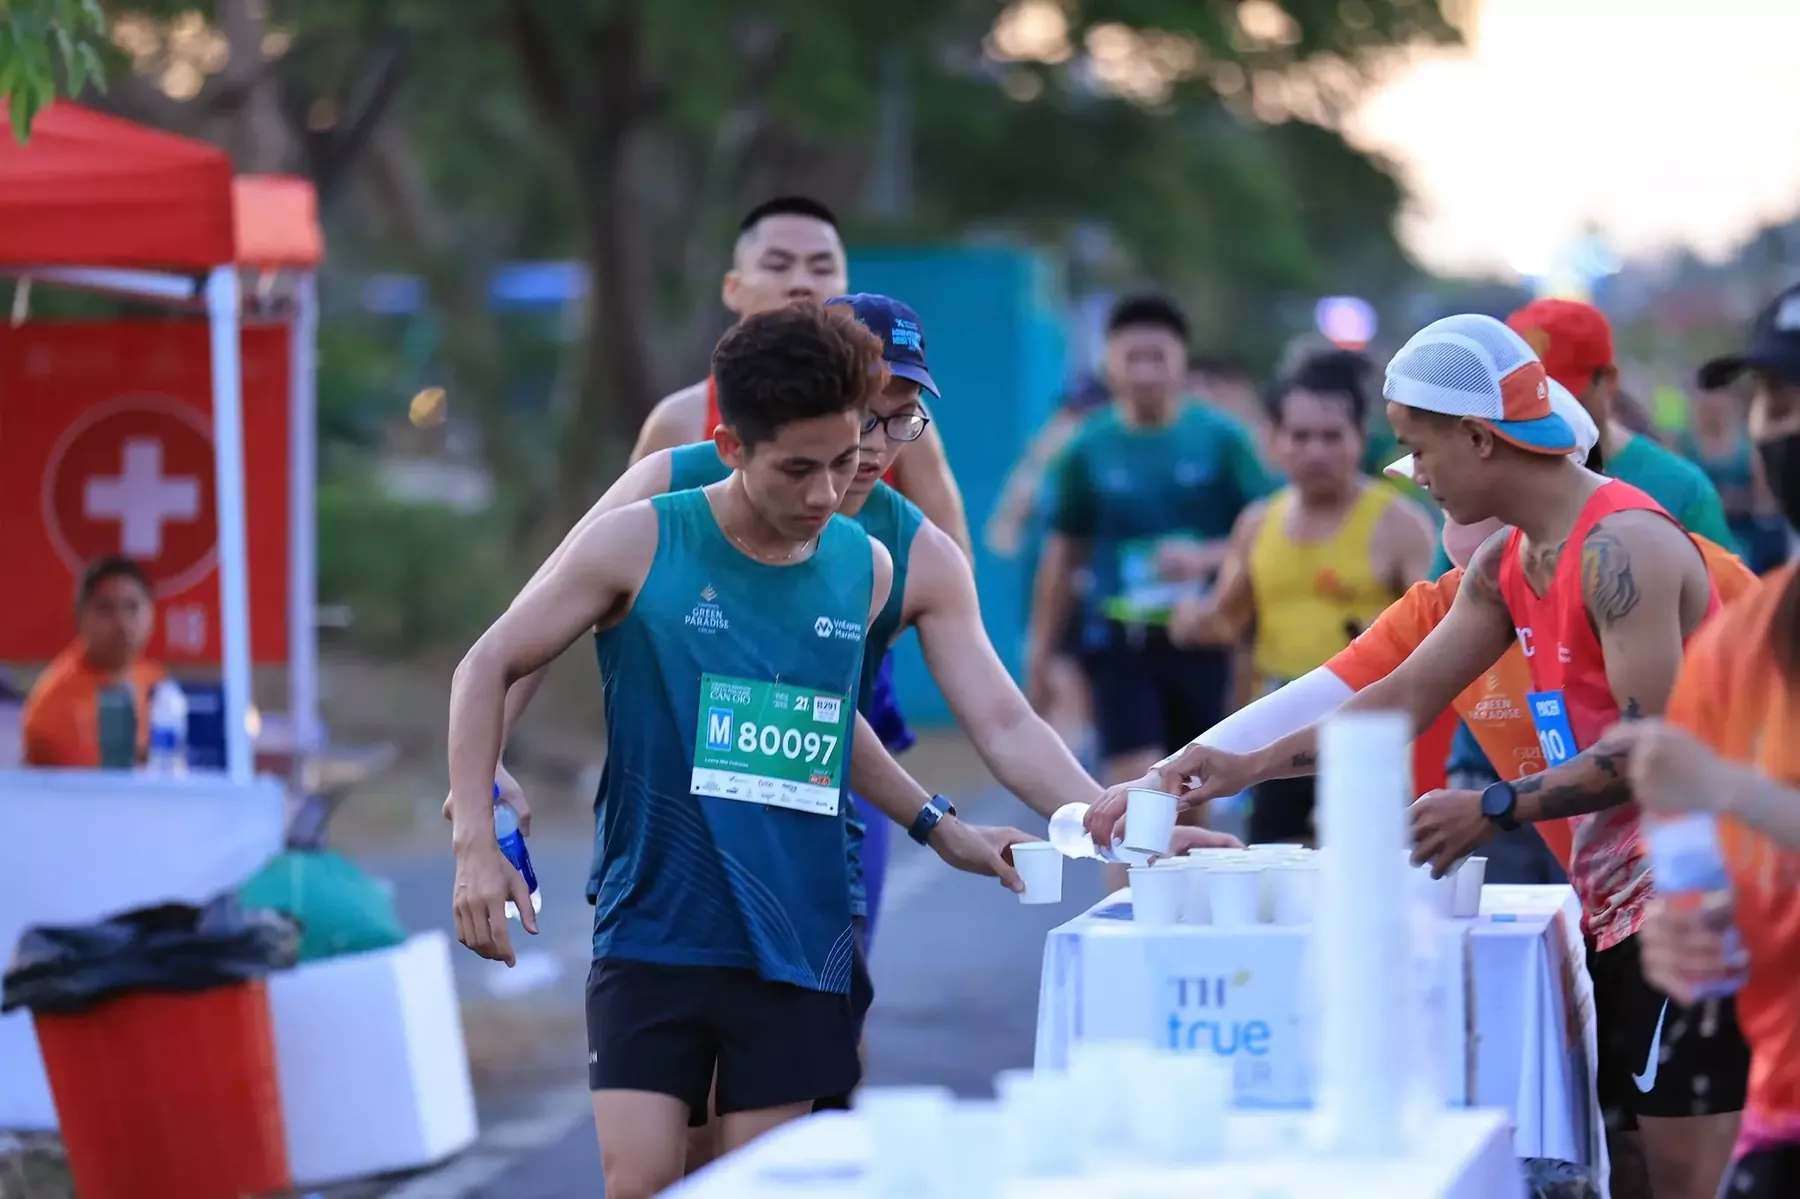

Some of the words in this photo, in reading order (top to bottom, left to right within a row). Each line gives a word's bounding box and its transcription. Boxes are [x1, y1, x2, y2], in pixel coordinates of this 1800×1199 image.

[685, 615, 729, 630] PARADISE
[692, 607, 724, 619] GREEN
[709, 713, 731, 745] M
[737, 721, 838, 766] 80097
[1167, 1012, 1271, 1056] true
